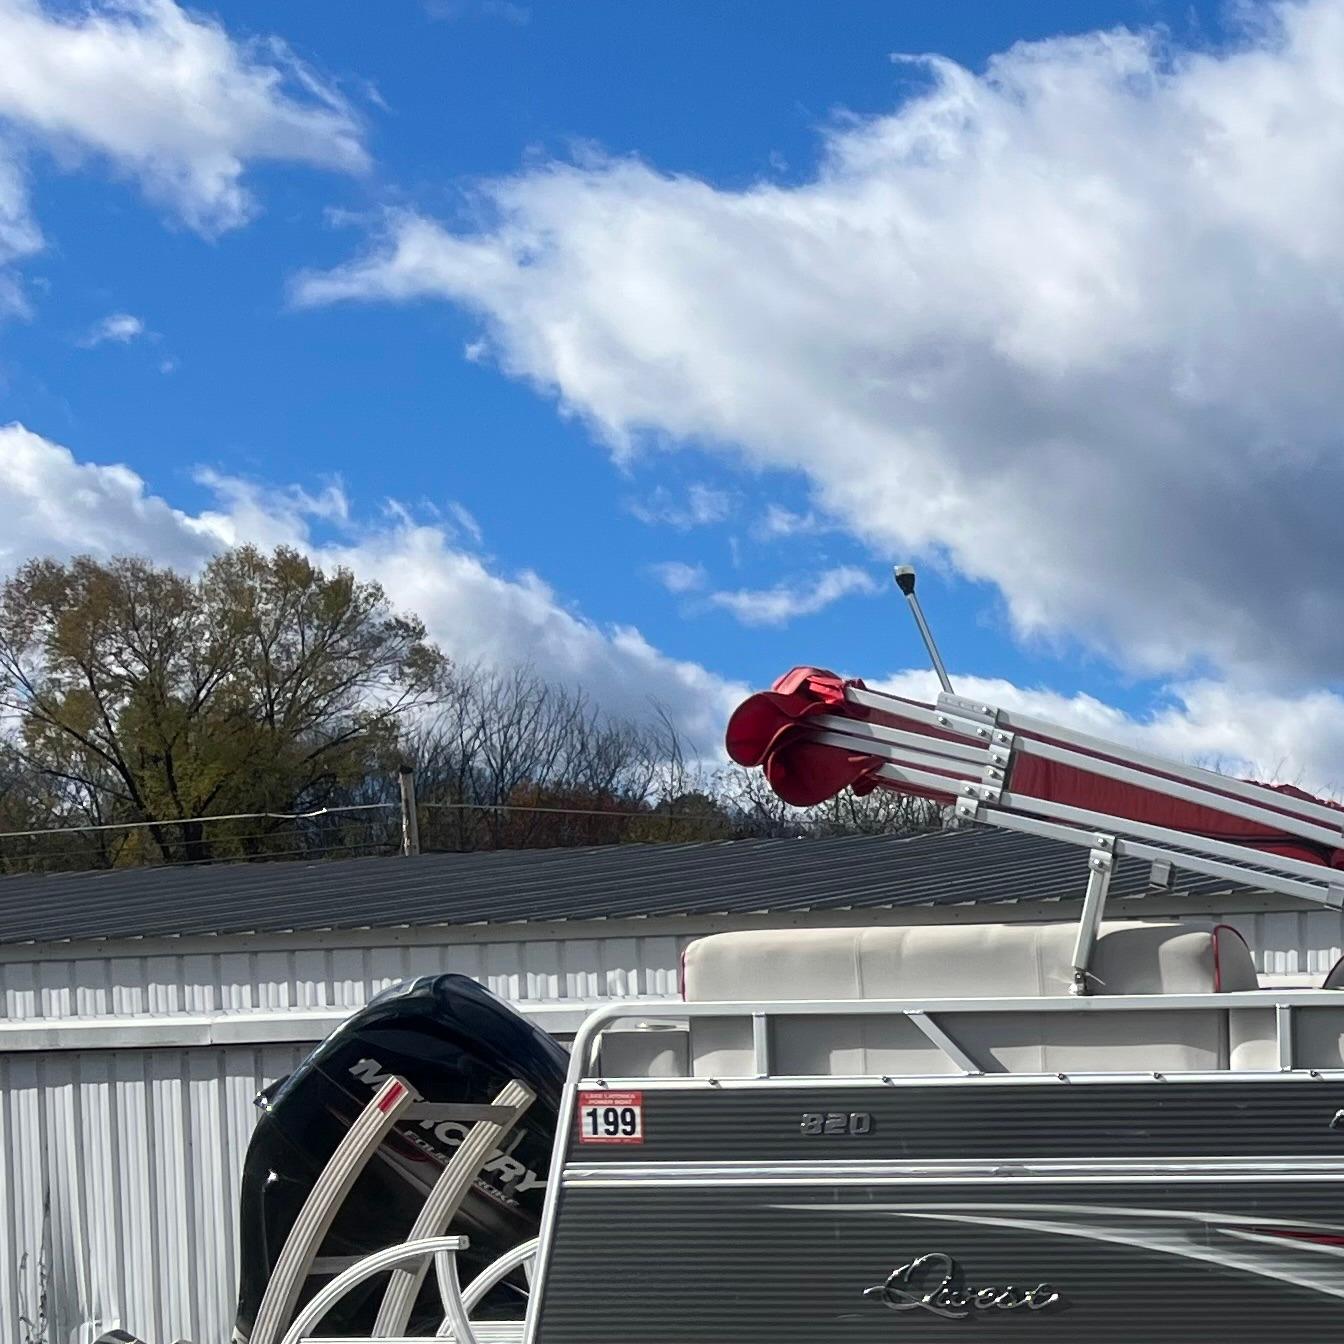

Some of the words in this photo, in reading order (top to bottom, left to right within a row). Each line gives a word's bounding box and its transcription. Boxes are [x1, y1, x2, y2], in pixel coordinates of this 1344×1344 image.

[586, 1107, 636, 1136] 199
[800, 1112, 871, 1135] 820
[863, 1252, 1060, 1319] Qwest
